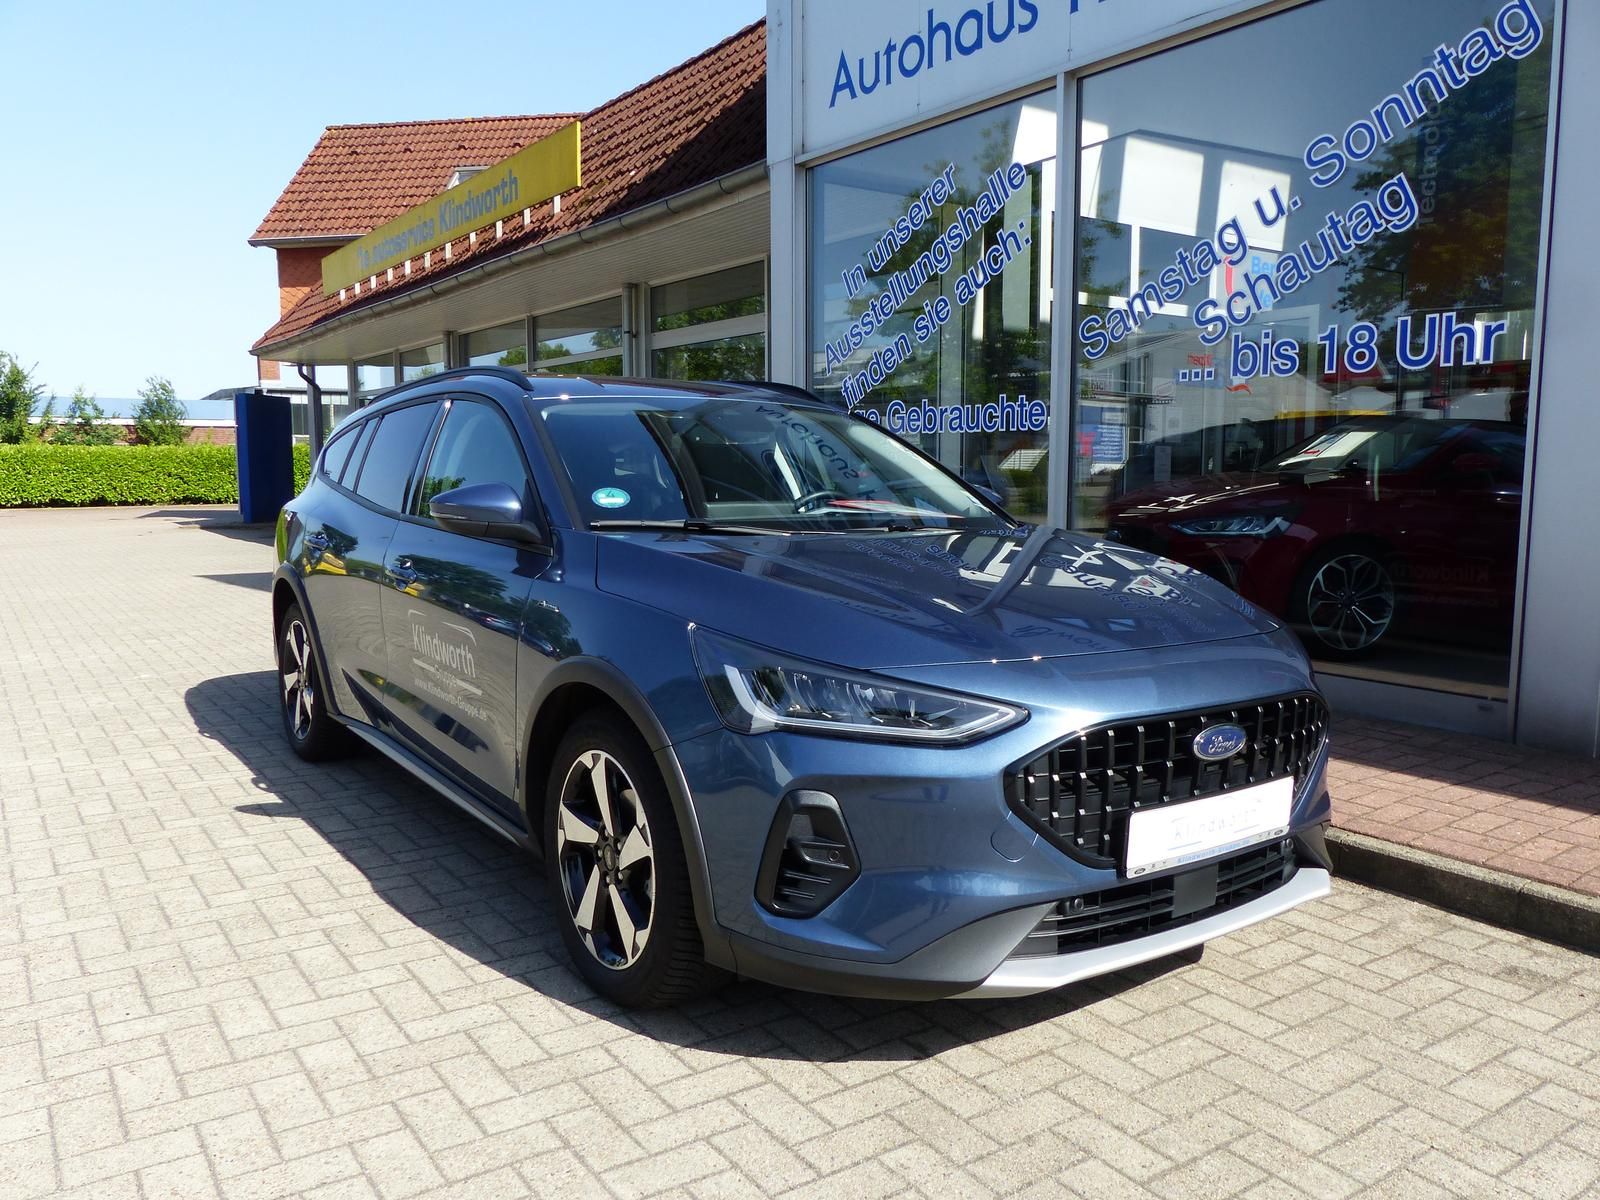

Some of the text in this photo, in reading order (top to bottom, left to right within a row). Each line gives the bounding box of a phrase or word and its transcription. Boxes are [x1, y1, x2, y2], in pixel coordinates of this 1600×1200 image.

[829, 0, 1039, 108] Autohaus
[439, 169, 519, 233] Klindworth
[842, 162, 957, 299] In unserer
[1078, 0, 1544, 360] Samstag u. Sonntag
[824, 161, 1027, 376] Ausstellungshalle
[1193, 172, 1419, 346] Schautag
[841, 220, 1032, 409] finden sie auch:
[1230, 330, 1300, 380] bis
[1317, 322, 1378, 374] 18
[1396, 312, 1507, 369] Uhr
[886, 394, 1048, 434] Gebrauchte
[412, 623, 476, 678] Klindworth
[1208, 735, 1240, 754] Ford
